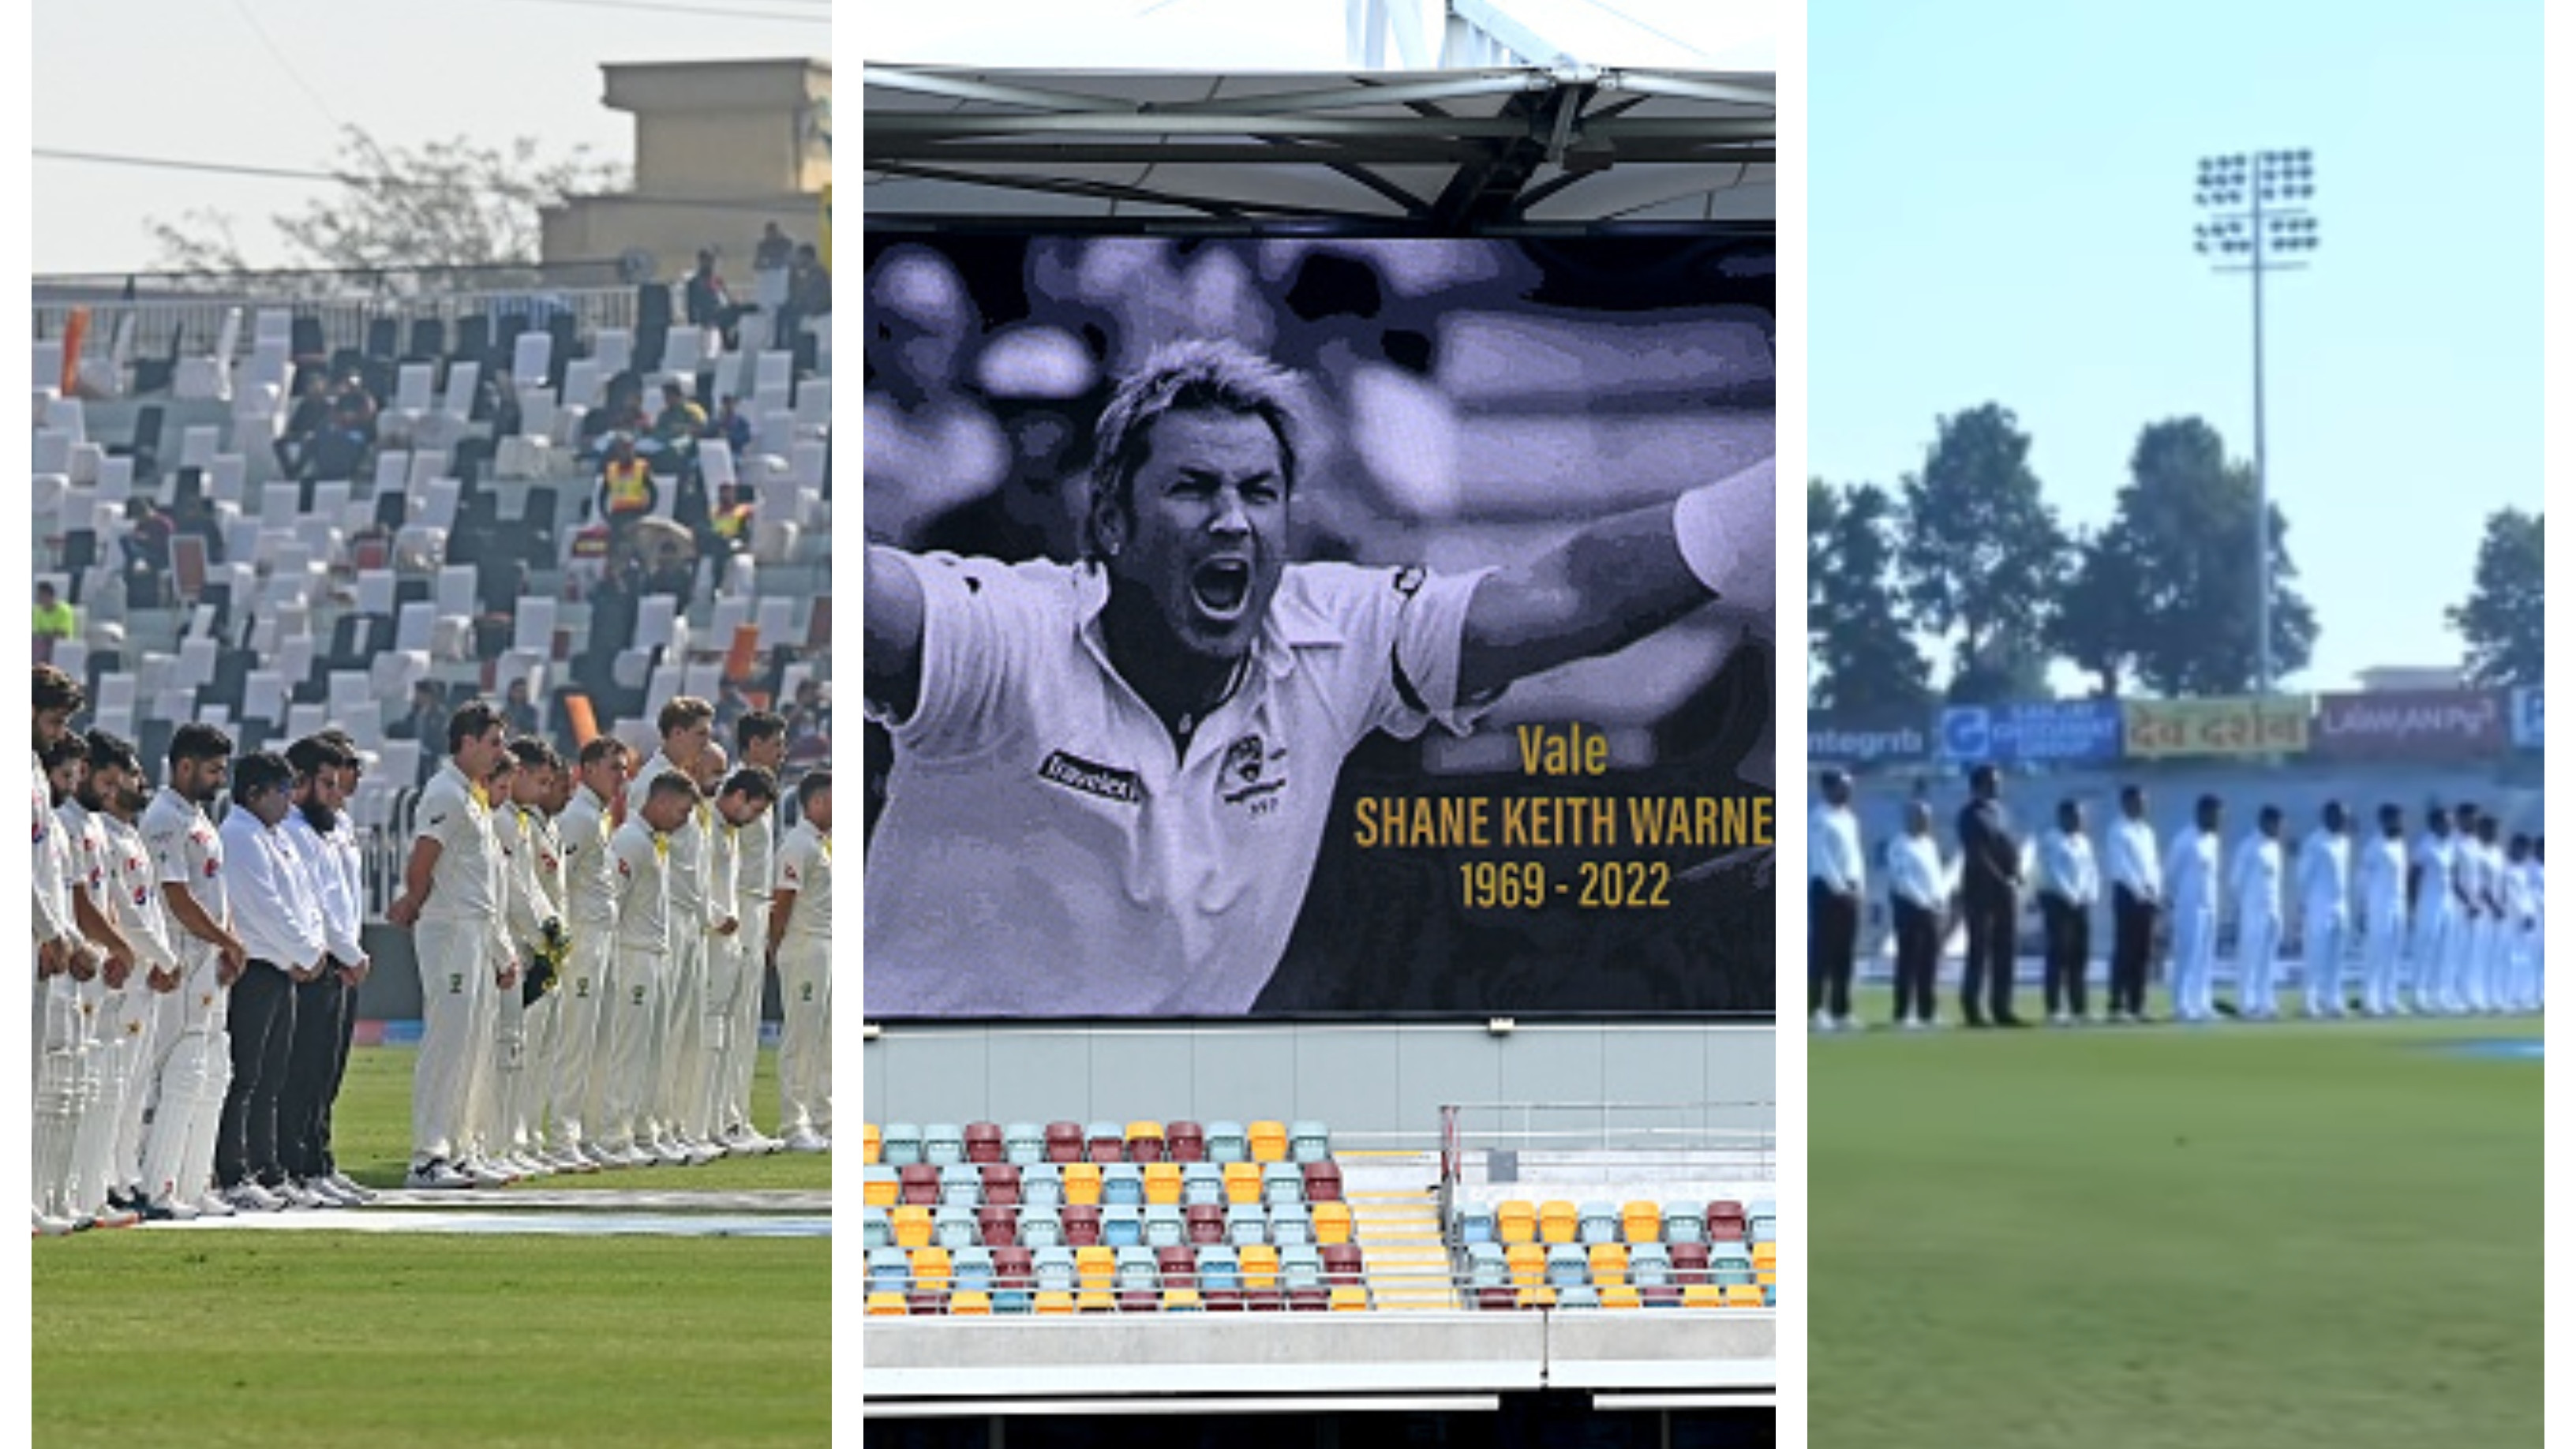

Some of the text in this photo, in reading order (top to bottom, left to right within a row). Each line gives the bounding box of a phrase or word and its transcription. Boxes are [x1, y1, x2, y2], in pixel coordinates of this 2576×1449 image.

[1517, 722, 1608, 776] Vale
[1355, 796, 1775, 847] SHANE KEITH WARNE
[1460, 861, 1544, 908] 1969
[1578, 861, 1670, 907] 2022
